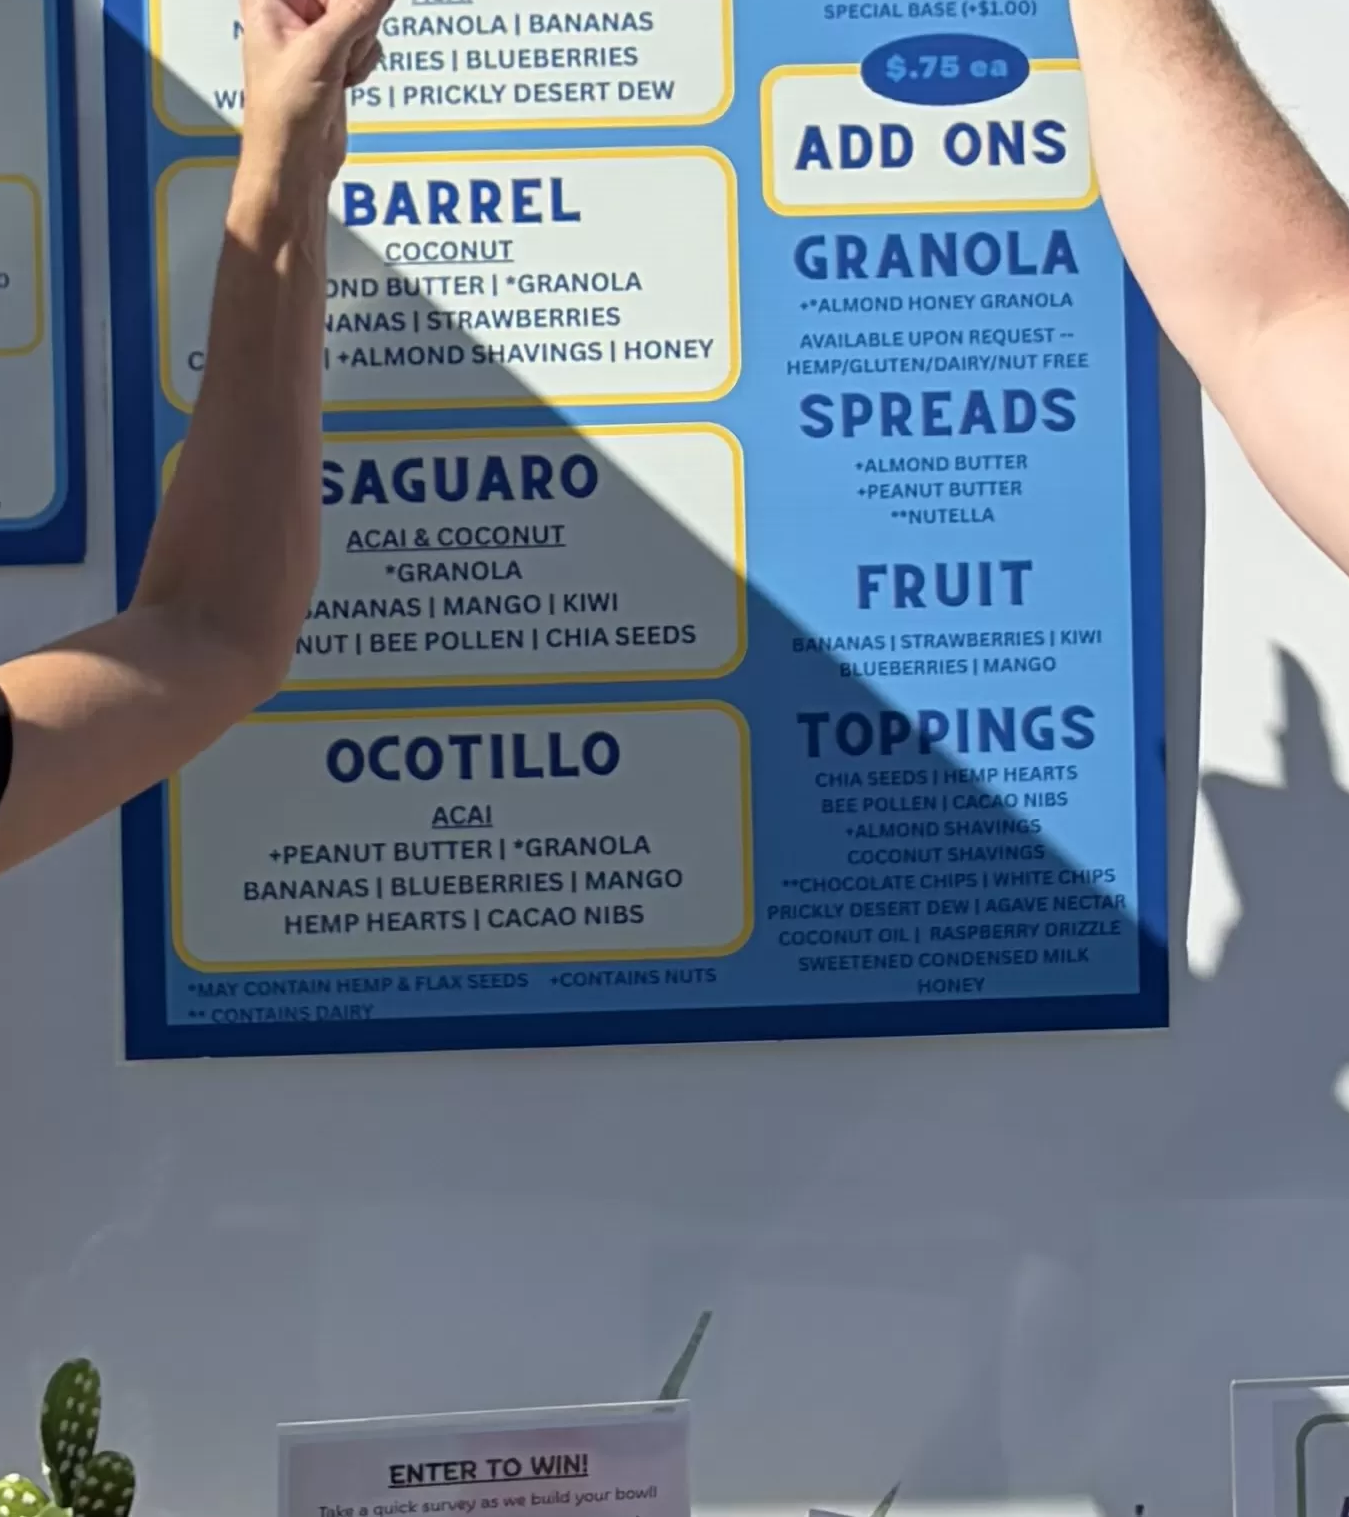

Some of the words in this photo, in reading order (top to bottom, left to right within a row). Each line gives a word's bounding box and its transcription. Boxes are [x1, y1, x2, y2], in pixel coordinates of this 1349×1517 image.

[824, 2, 903, 20] SPECIAL
[908, 1, 957, 18] BASE
[529, 12, 654, 34] BANANAS
[467, 47, 639, 70] BLUEBERRIES
[886, 54, 959, 83] $.75
[970, 59, 1008, 78] ea
[404, 84, 506, 107] PRICKLY
[513, 83, 611, 104] DESERT
[618, 80, 676, 102] DEW
[795, 122, 914, 171] ADD
[944, 119, 1066, 167] ONS
[343, 177, 581, 227] BARREL
[385, 240, 514, 264] COCONUT
[794, 229, 1079, 280] GRANOLA
[387, 276, 484, 298] BUTTER
[908, 294, 976, 311] HONEY
[980, 292, 1073, 309] GRANOLA
[426, 307, 620, 331] STRAWBERRIES
[800, 330, 903, 349] AVAILABLE
[908, 330, 963, 346] UPON
[968, 327, 1054, 346] REQUEST
[472, 342, 602, 364] SHAVINGS
[624, 338, 715, 361] HONEY
[787, 354, 1037, 376] HEMP/GLUTEN/DAIRY/NUT
[1043, 353, 1088, 369] FREE
[799, 387, 1077, 439] SPREADS
[955, 454, 1027, 471] BUTTER
[321, 454, 598, 505] SAGUARO
[950, 481, 1023, 497] BUTTER
[347, 528, 406, 551] ACAI
[437, 524, 565, 548] COCONUT
[857, 559, 1033, 610] FRUIT
[443, 594, 541, 616] MANGO
[562, 591, 618, 613] KIWI
[369, 631, 418, 654] BEE
[424, 628, 525, 651] POLLEN
[545, 626, 609, 648] CHIA
[614, 624, 696, 646] SEEDS
[792, 635, 886, 653] BANANAS
[900, 631, 1045, 649] STRAWBERRIES
[1060, 629, 1102, 645] KIWI
[839, 659, 967, 678] BLUEBERRIES
[983, 656, 1056, 674] MANGO
[796, 705, 1095, 758] TOPPINGS
[326, 730, 621, 784] OCOTILLO
[815, 771, 862, 788] CHIA
[867, 769, 927, 786] SEEDS
[944, 767, 999, 784] HEMP
[1003, 765, 1078, 782] HEARTS
[821, 798, 857, 814] BEE
[863, 797, 937, 813] POLLEN
[953, 794, 1018, 811] CACAO
[1023, 792, 1068, 807] NIBS
[431, 804, 493, 828] ACAI
[944, 819, 1041, 836] SHAVINGS
[269, 843, 386, 866] +PEANUT
[393, 841, 493, 863] BUTTER
[847, 848, 943, 866] COCONUT
[948, 845, 1044, 862] SHAVINGS
[244, 877, 370, 902] BANANAS
[391, 872, 564, 897] BLUEBERRIES
[585, 868, 684, 892] MANGO
[919, 872, 978, 890] CHIPS
[993, 870, 1053, 887] WHITE
[1058, 868, 1116, 885] CHIPS
[284, 912, 360, 935] HEMP
[366, 910, 466, 933] HEARTS
[488, 907, 577, 930] CACAO
[584, 904, 644, 926] NIBS
[768, 903, 843, 920] PRICKLY
[849, 901, 921, 918] DESERT
[927, 900, 969, 916] DEW
[985, 897, 1048, 913] AGAVE
[1053, 895, 1126, 911] NECTAR
[778, 929, 873, 946] COCONUT
[878, 928, 910, 944] OIL
[930, 925, 1039, 942] RASPBERRY
[1045, 921, 1121, 937] DRIZZLE
[798, 953, 913, 972] SWEETENED
[918, 950, 1038, 969] CONDENSED
[1043, 948, 1089, 965] MILK
[243, 979, 331, 998] CONTAIN
[335, 976, 394, 995] HEMP
[415, 974, 463, 992] FLAX
[467, 972, 528, 990] SEEDS
[665, 967, 717, 985] NUTS
[918, 977, 985, 995] HONEY
[212, 1004, 310, 1025] CONTAINS
[316, 1002, 374, 1022] DAIRY
[388, 1460, 477, 1486] ENTER
[486, 1457, 521, 1480] TO
[532, 1454, 588, 1478] WIN!
[373, 1501, 417, 1517] quick
[422, 1498, 476, 1515] survey
[481, 1499, 501, 1510] as
[504, 1495, 526, 1508] we
[530, 1491, 571, 1506] build
[575, 1488, 611, 1505] your
